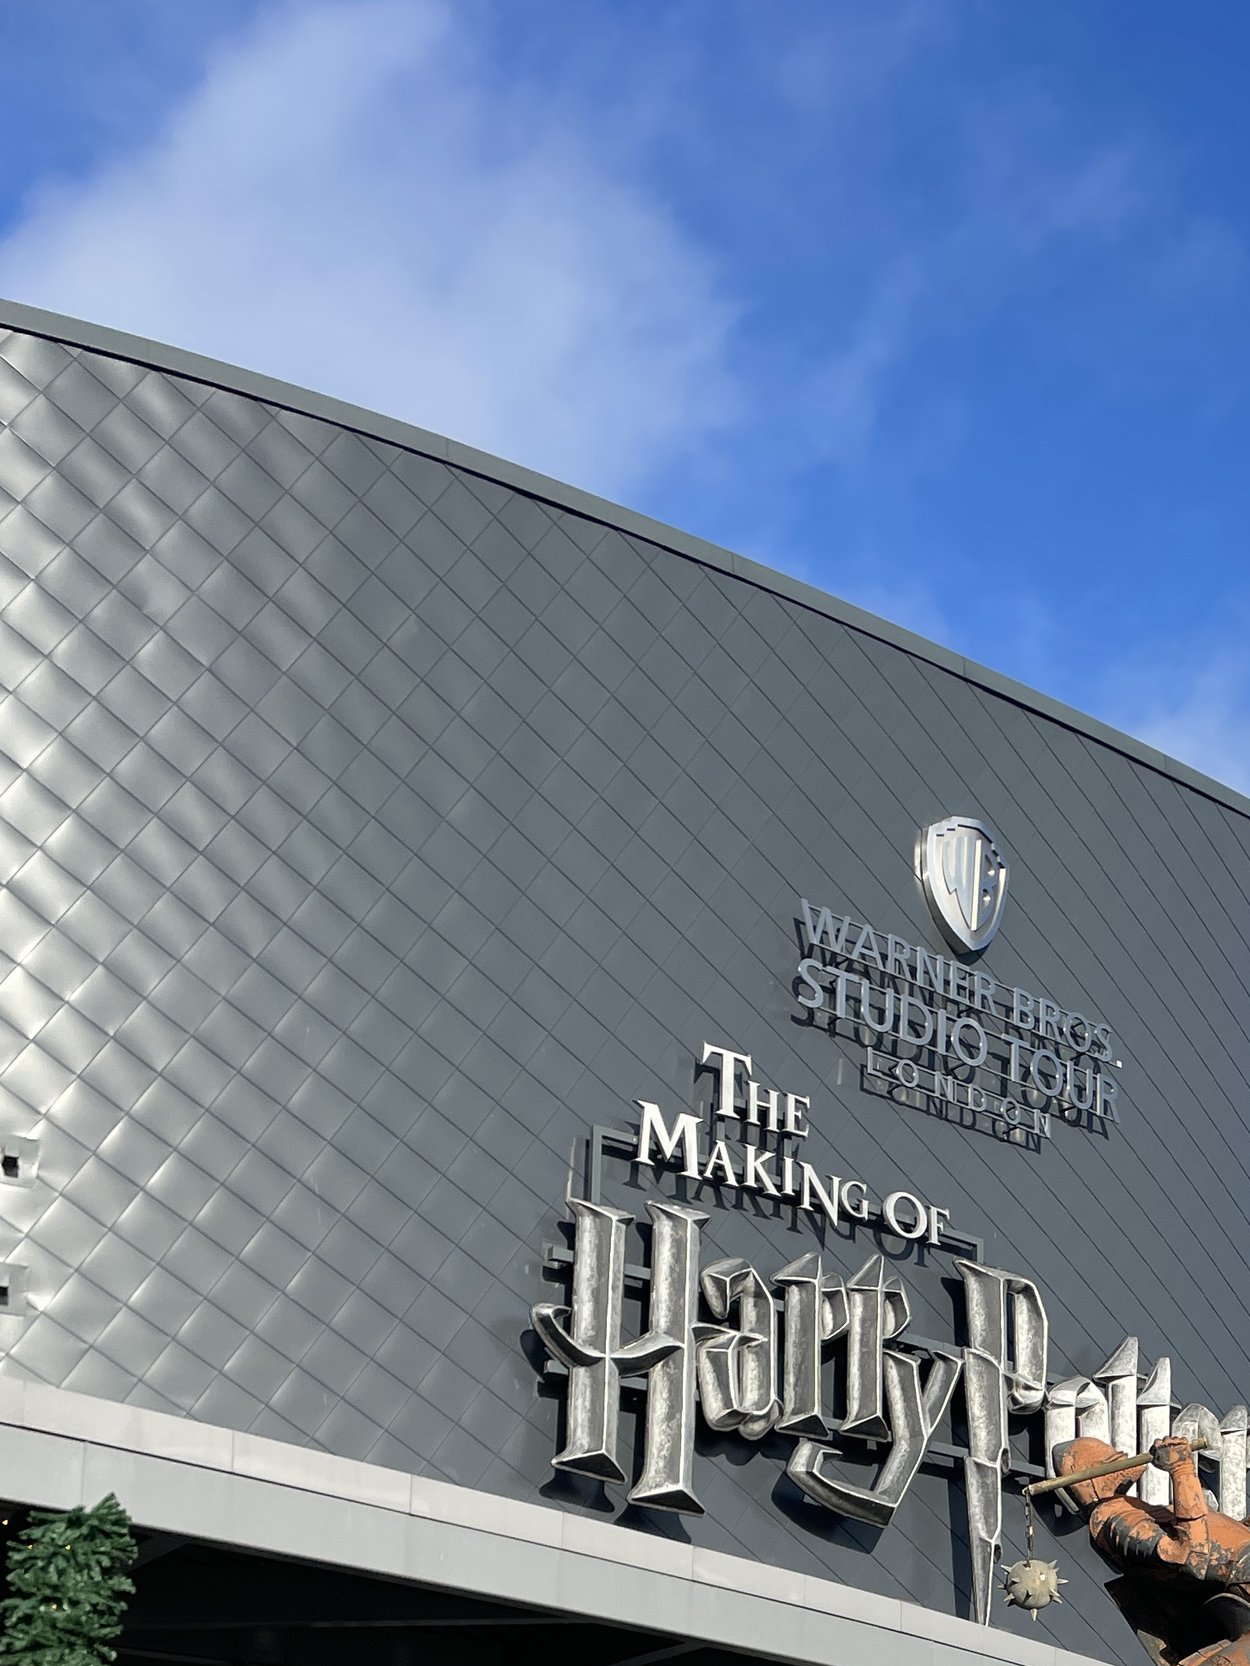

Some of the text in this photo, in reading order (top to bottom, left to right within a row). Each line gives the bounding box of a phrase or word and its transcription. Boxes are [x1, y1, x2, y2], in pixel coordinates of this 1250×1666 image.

[797, 957, 1120, 1124] STUDIO TOUR
[801, 898, 1122, 1068] WARNER BROS.
[702, 1041, 810, 1137] THE
[867, 1046, 1051, 1139] LONDON
[632, 1099, 951, 1246] MAKING OF
[529, 1197, 965, 1528] Harry
